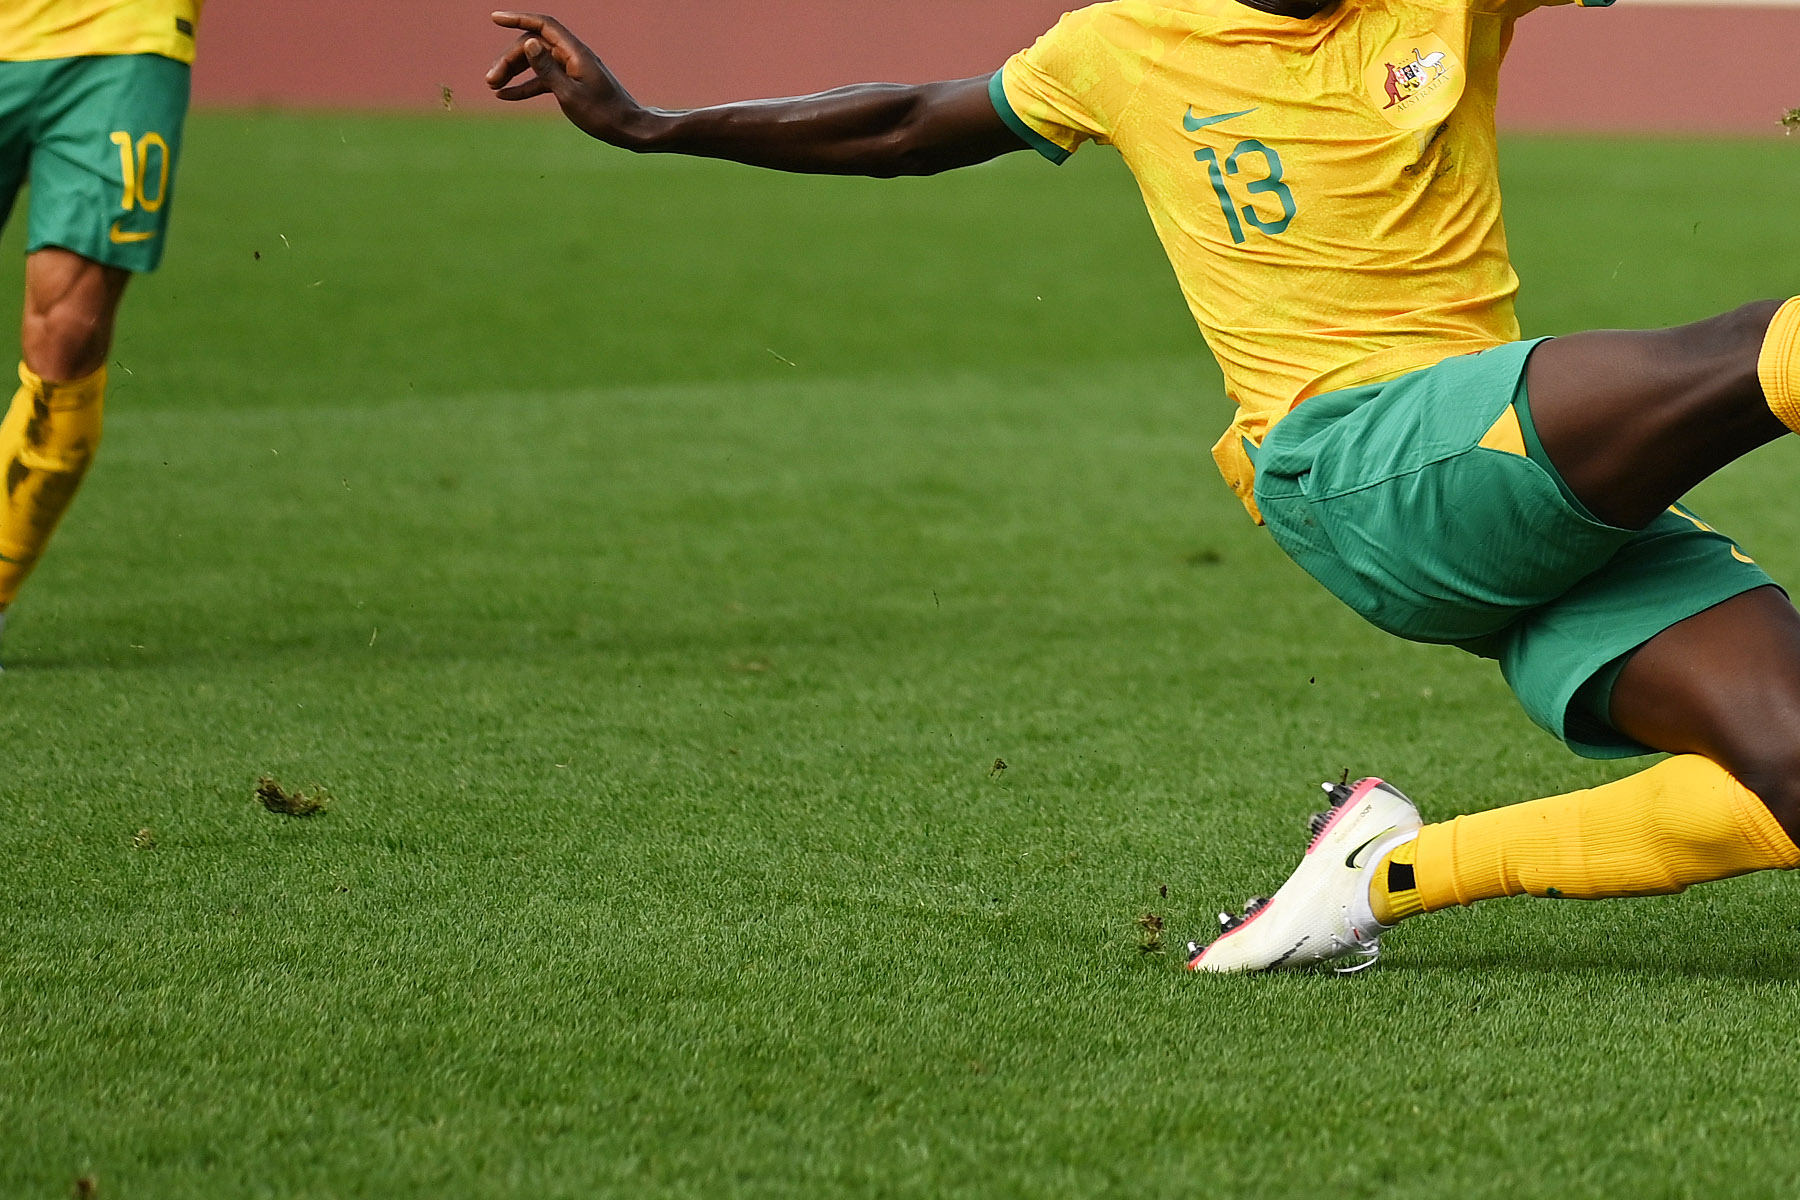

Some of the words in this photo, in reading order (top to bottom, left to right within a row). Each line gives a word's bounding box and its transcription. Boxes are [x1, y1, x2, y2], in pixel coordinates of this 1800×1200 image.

[1397, 75, 1450, 112] AUSTRALIA
[109, 131, 169, 212] 10
[1194, 139, 1297, 244] 13
